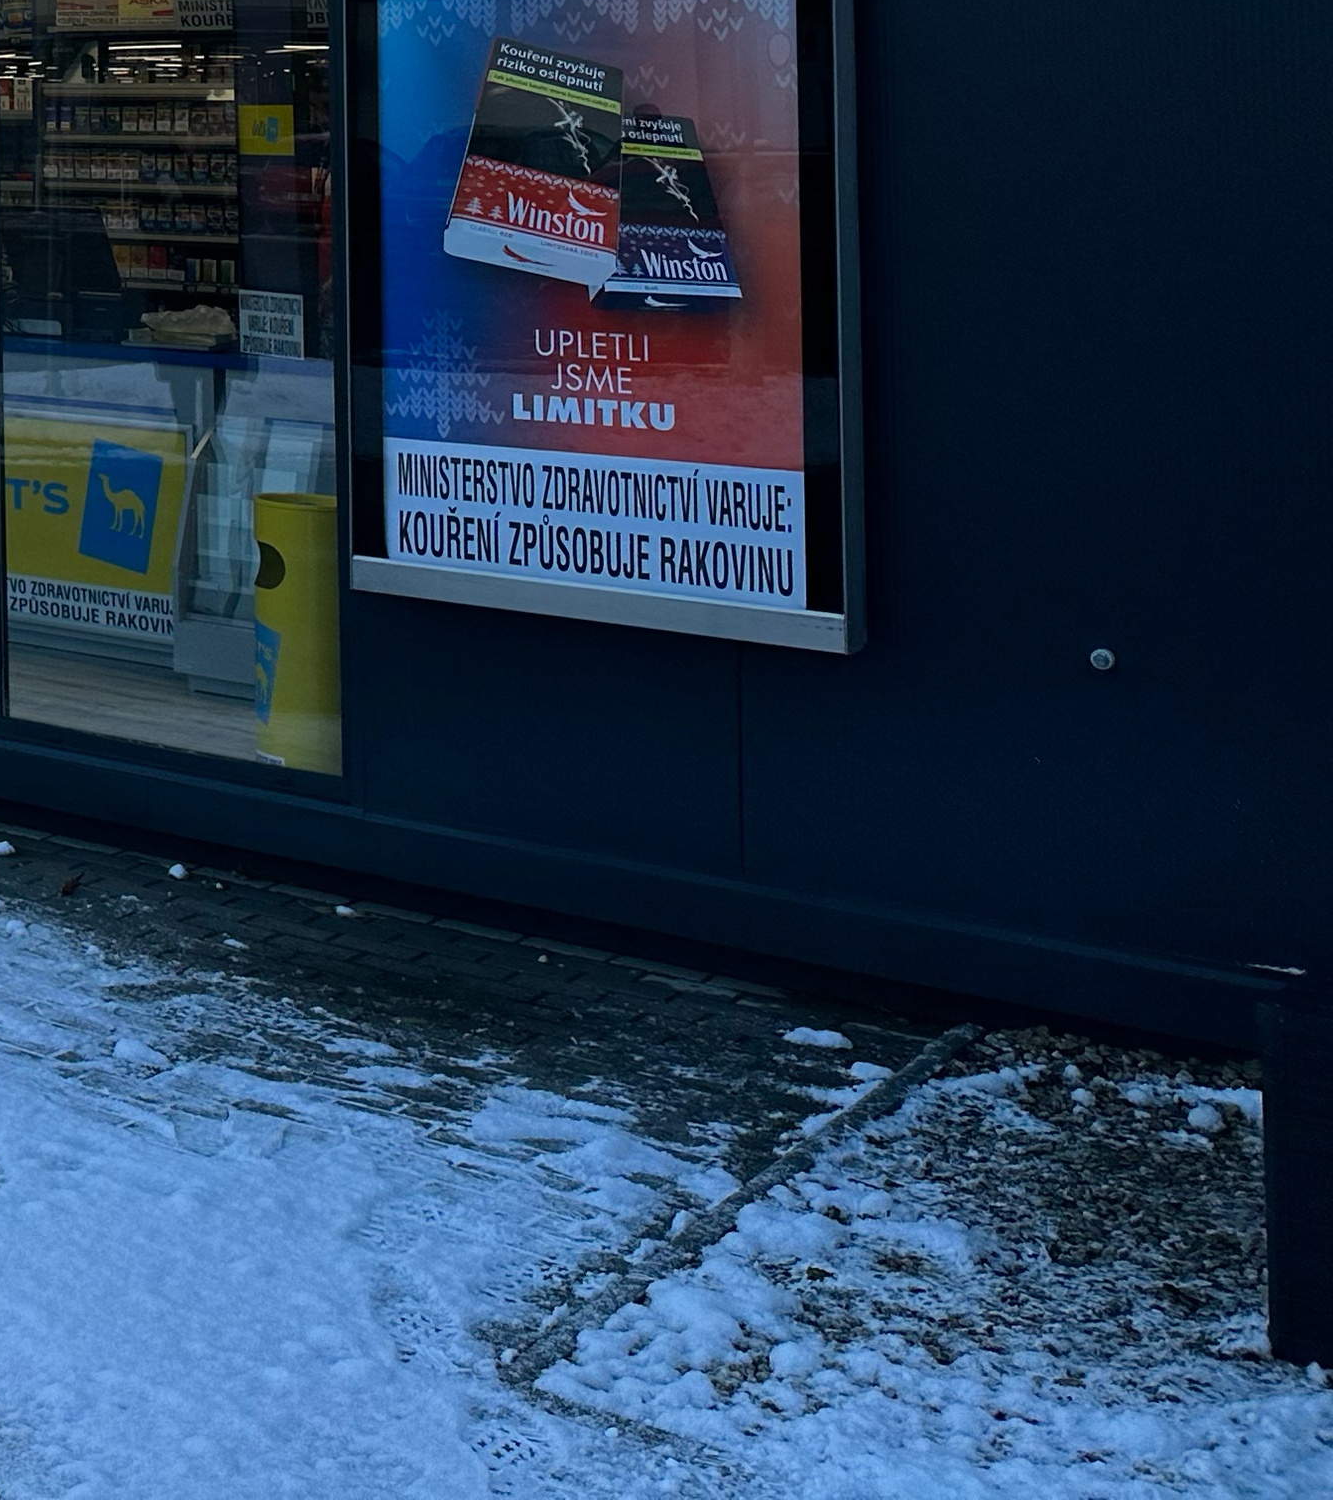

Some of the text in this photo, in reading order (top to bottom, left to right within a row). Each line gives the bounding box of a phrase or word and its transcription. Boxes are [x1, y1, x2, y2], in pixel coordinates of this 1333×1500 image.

[496, 56, 604, 93] riziko oslepnutí
[500, 43, 606, 80] Kouření zvyšuje
[628, 130, 684, 144] oslepnutí
[639, 119, 682, 132] zvyšuje
[506, 190, 605, 245] Winston
[639, 248, 729, 282] Winston
[534, 328, 649, 362] UPLETLI
[550, 362, 633, 395] JSME
[512, 393, 676, 432] LIMITKU
[398, 452, 792, 533] MINISTERSTVO ZDRAVOTNICTVÍ VARUJE:
[399, 506, 794, 597] KOUŘENÍ ZPŮSOBUJE RAKOVINU
[9, 596, 100, 624] ZPŮSOBUJE
[30, 581, 131, 609] ZDRAVOTNICTVÍ
